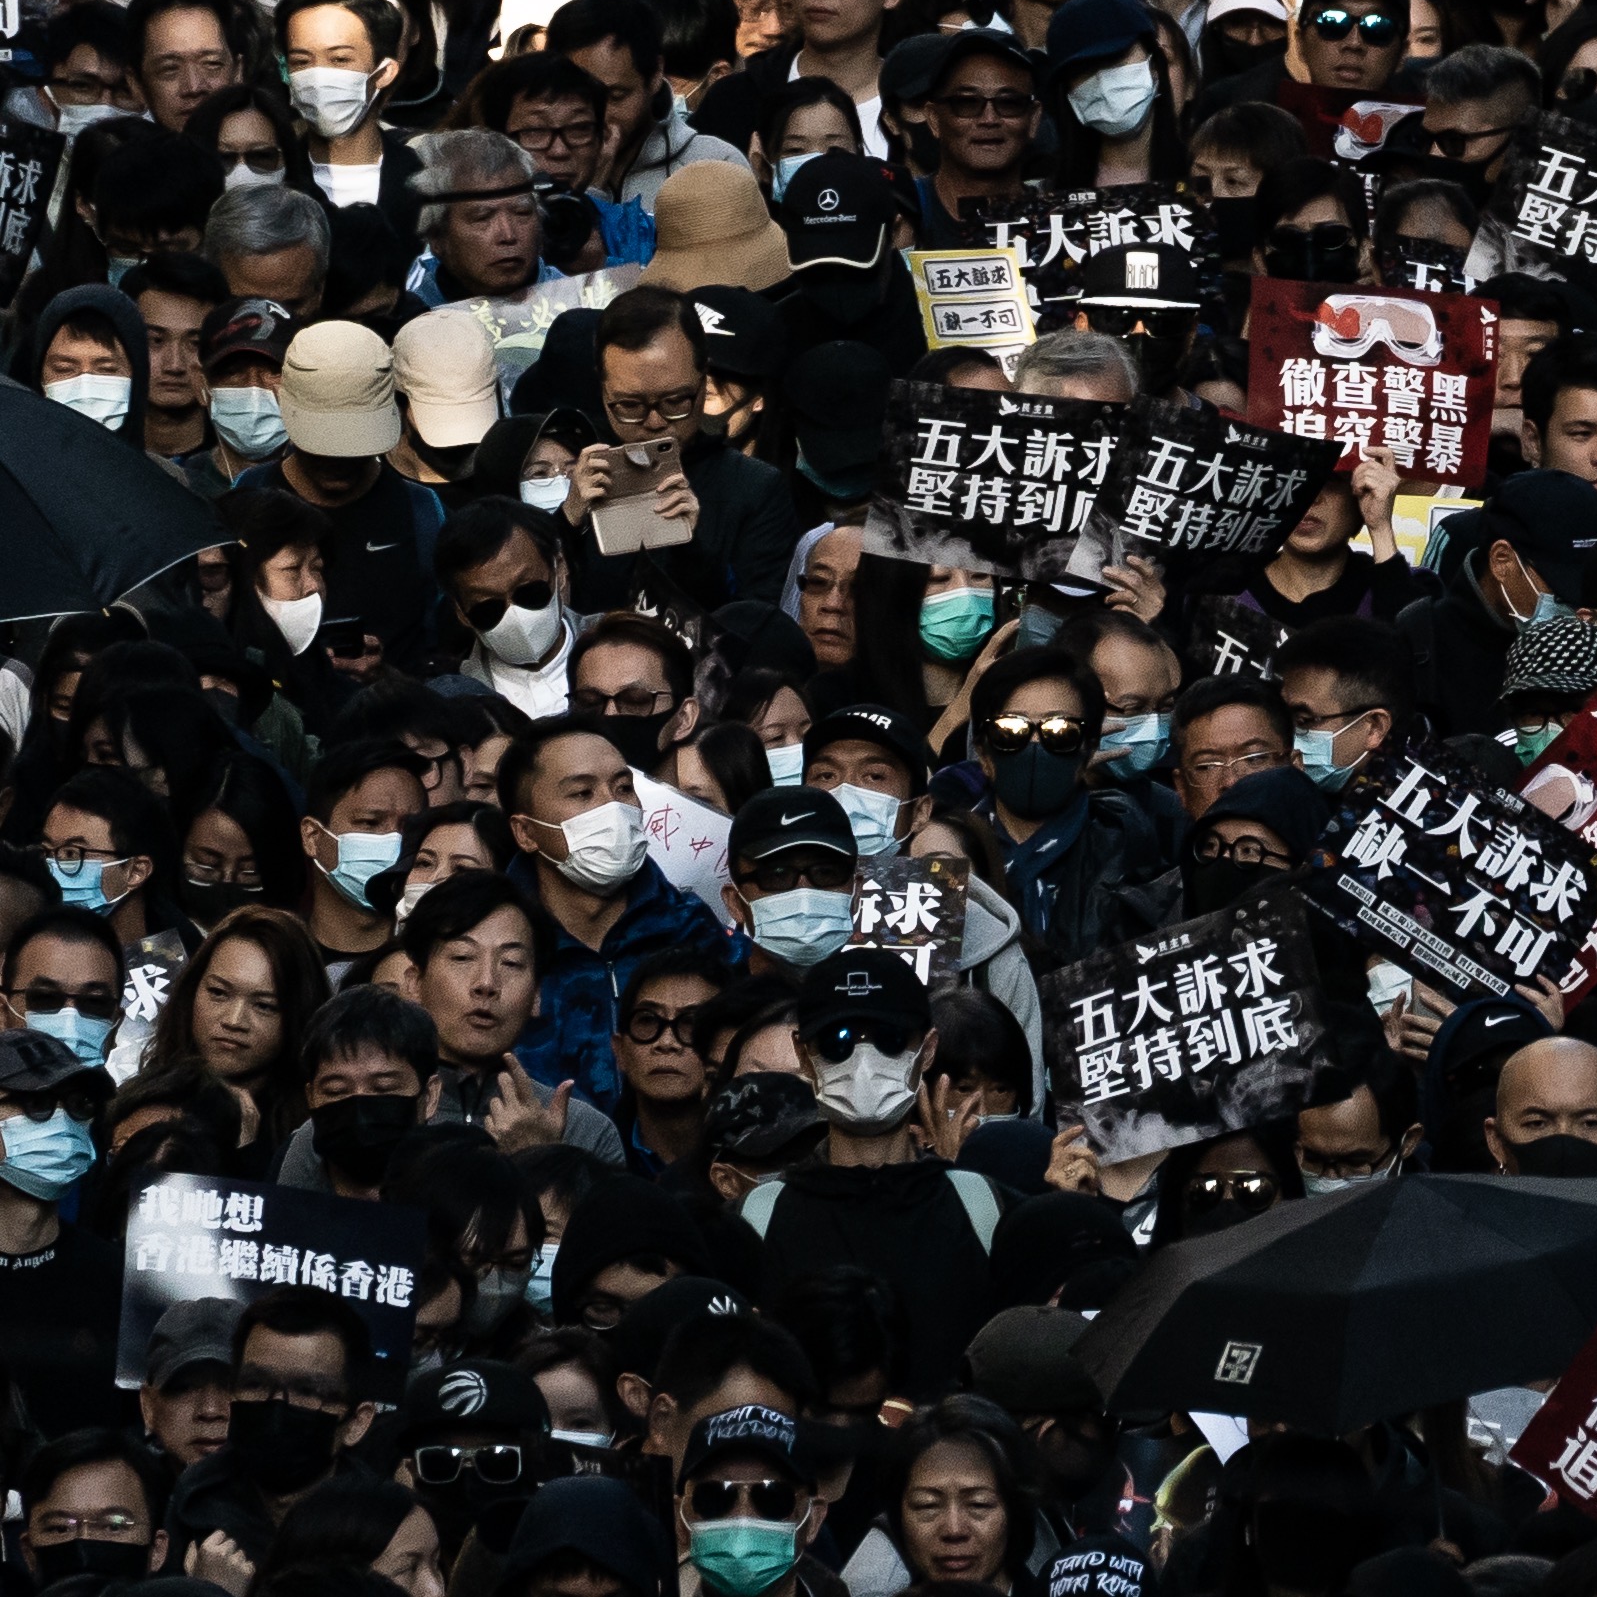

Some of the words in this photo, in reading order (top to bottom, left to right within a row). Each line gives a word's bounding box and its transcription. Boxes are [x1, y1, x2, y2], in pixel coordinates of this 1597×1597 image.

[1278, 357, 1468, 424] 徹查警黑
[910, 416, 1120, 484] 五大訴求
[1145, 436, 1308, 509] 五大訴求
[1120, 484, 1285, 549] 堅持到底
[1377, 756, 1588, 924] 五大訴求
[1345, 809, 1557, 979] 缺一不可
[1070, 939, 1285, 1054] 五大訴求
[1075, 999, 1297, 1104] 堅持到底
[140, 1184, 262, 1232] 我哋想
[135, 1236, 415, 1307] 香港繼續係香港
[1050, 1552, 1103, 1579] STAND
[1106, 1557, 1143, 1580] WITH
